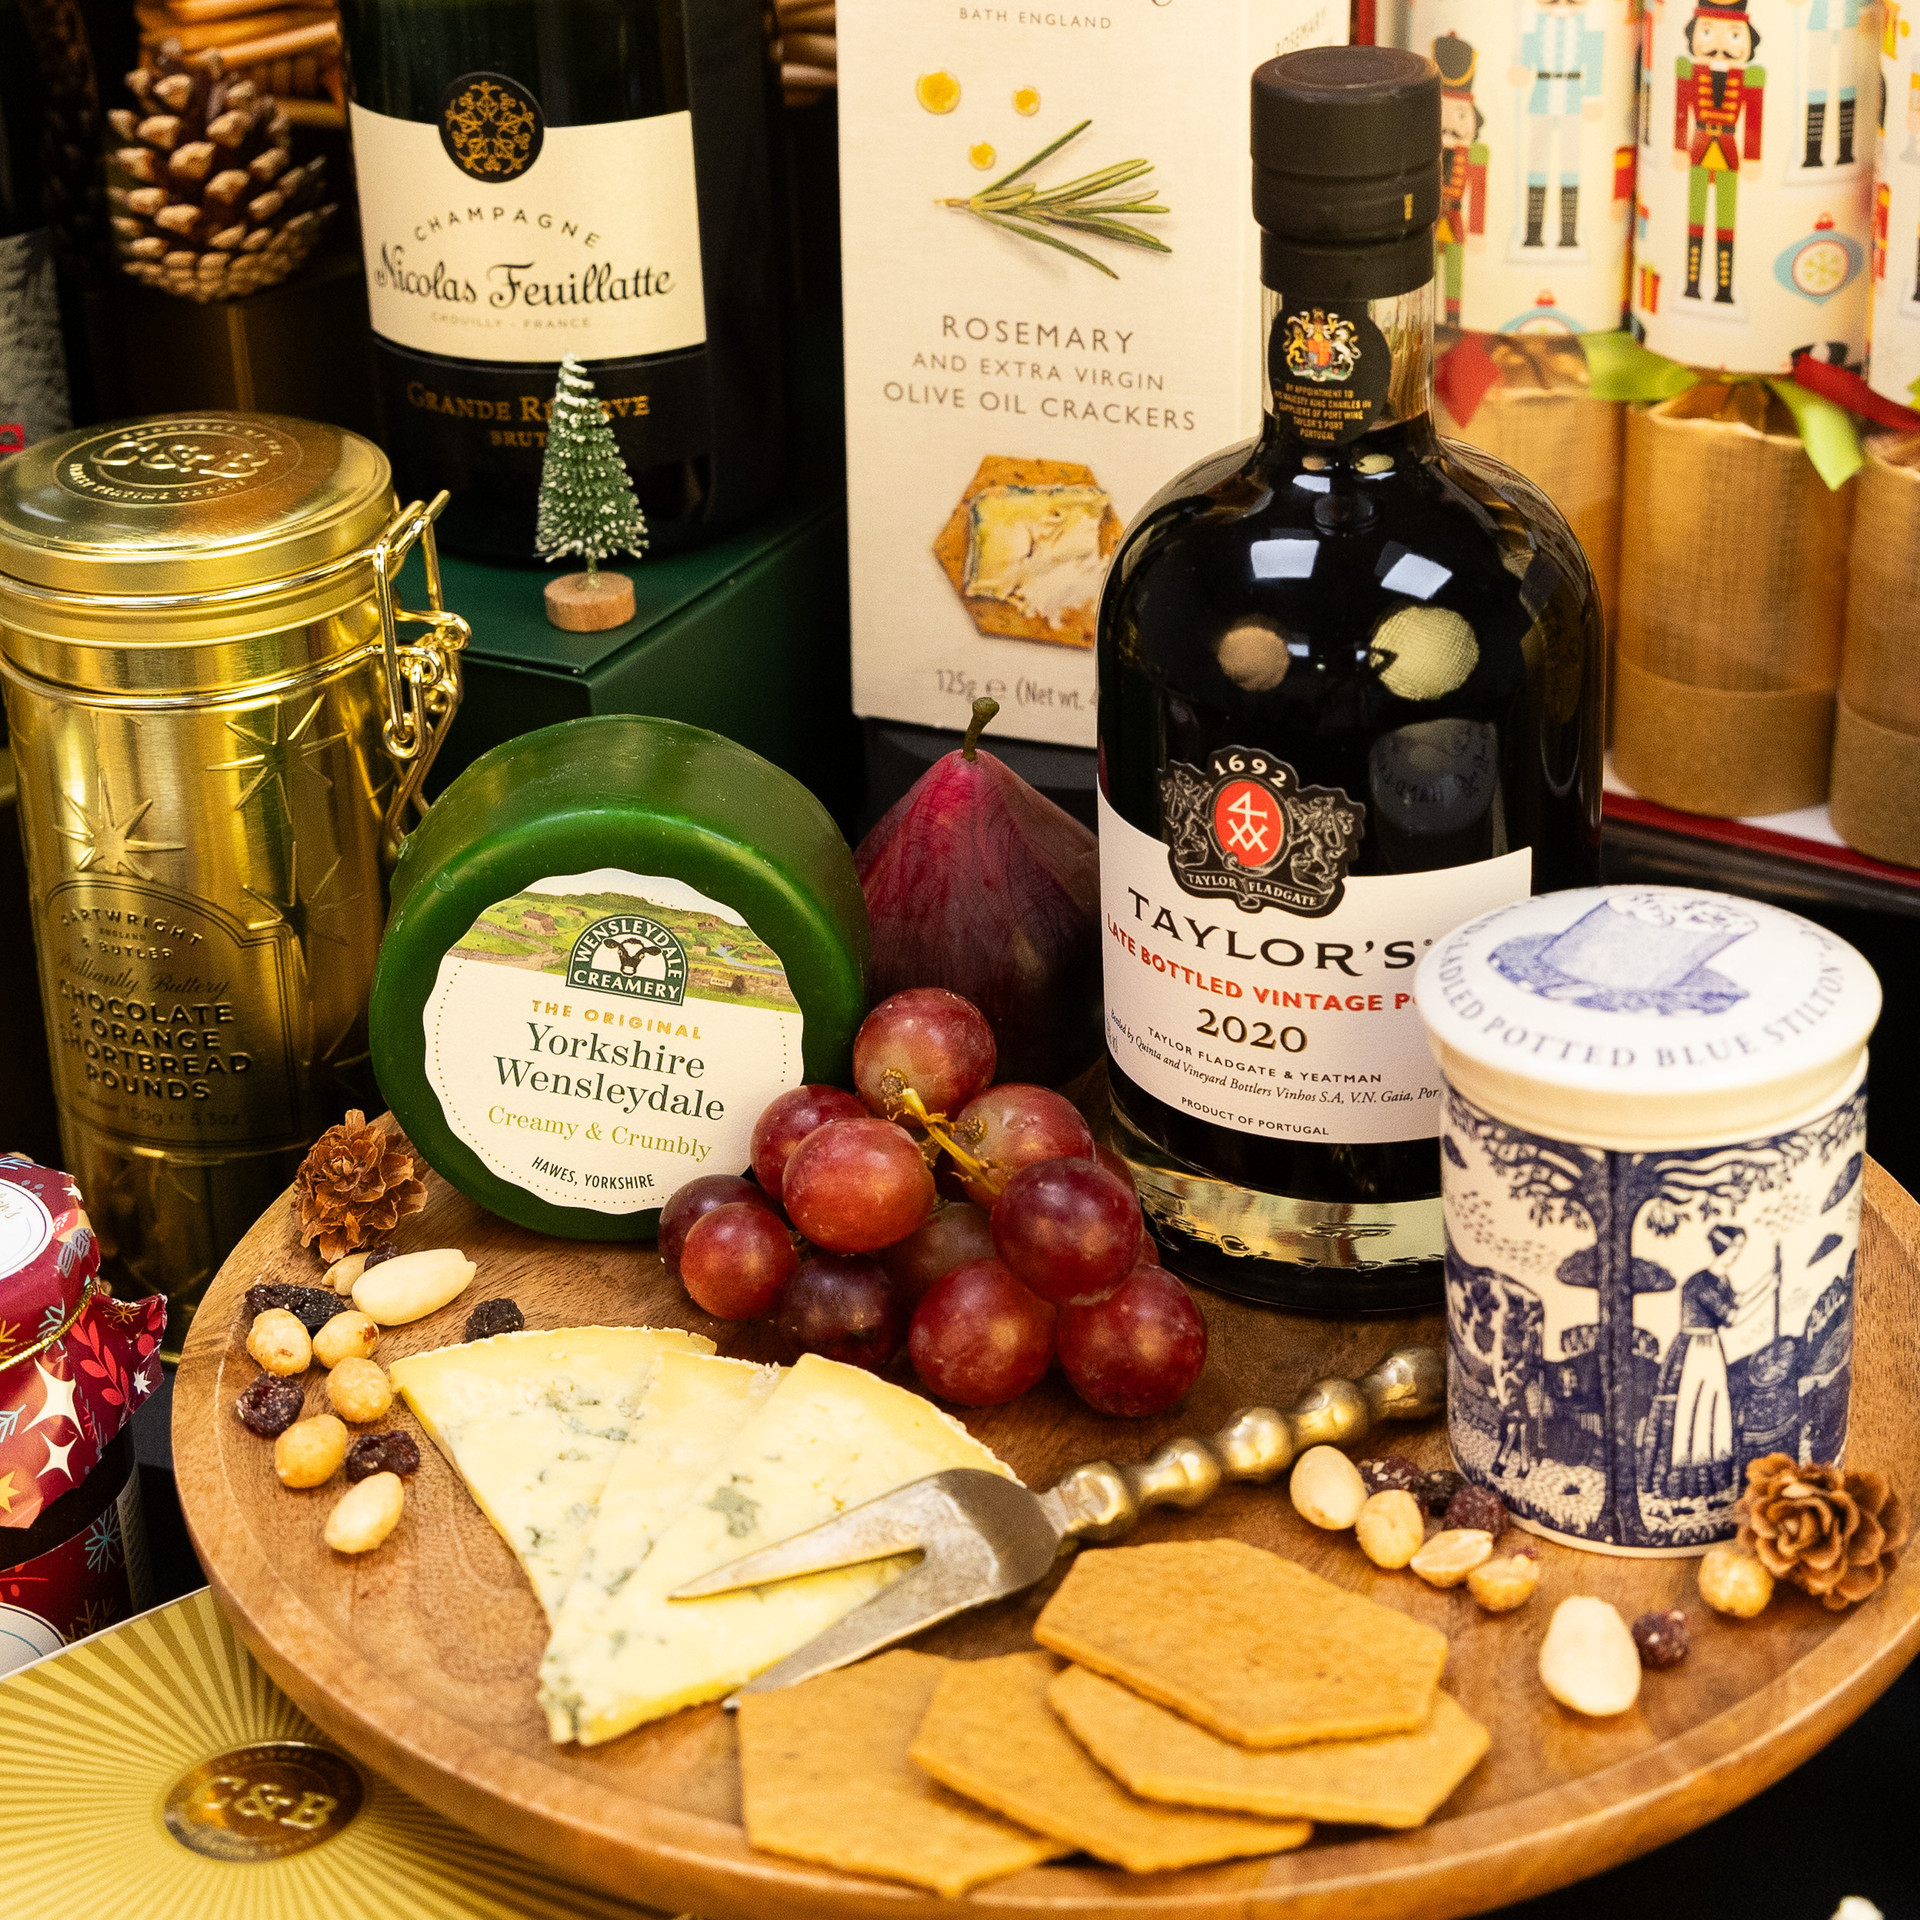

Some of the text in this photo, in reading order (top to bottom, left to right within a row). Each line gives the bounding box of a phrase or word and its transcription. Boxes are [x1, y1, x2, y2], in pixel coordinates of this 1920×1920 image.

[959, 7, 1112, 29] BATH ENGLAND
[414, 207, 601, 248] CHAMPAGNE
[375, 242, 676, 308] Nicolas Feuillatte
[523, 318, 591, 328] FRANCE
[942, 315, 1134, 354] ROSEMARY
[912, 352, 1164, 391] AND EXTRA VIRGIN
[883, 382, 1195, 431] OLIVE OIL CRACKERS
[1328, 400, 1360, 409] CHARLES
[1344, 410, 1363, 420] WINE
[490, 430, 548, 447] BRUT
[1300, 428, 1335, 440] PORTUGAL
[937, 669, 977, 704] 125g
[1015, 676, 1053, 707] (Net
[1214, 754, 1287, 788] 1692
[1187, 873, 1318, 907] TAYLOR FLADGATE
[61, 908, 203, 945] CARTWRIGHT
[100, 928, 146, 941] ENGLAND
[99, 940, 173, 960] BUTLER
[575, 918, 683, 979] WENSLEYDALE
[1107, 912, 1416, 1012] LATE BOTTLED VINTAGE P
[59, 978, 235, 1024] CHOCOLATE
[147, 974, 231, 1000] Buttery
[573, 970, 680, 1000] CREAMERY
[71, 1007, 221, 1050] & ORANGE
[532, 999, 702, 1040] THE ORIGINAL
[1197, 1007, 1308, 1053] 2020
[527, 1021, 706, 1079] Yorkshire
[1148, 1026, 1381, 1083] TAYLOR FLADGATE & YEATMAN
[1483, 1016, 1637, 1068] POTTED
[1655, 1034, 1760, 1068] BLUE
[86, 1061, 212, 1101] ROUNDS
[1127, 1029, 1135, 1044] by
[1136, 1036, 1161, 1061] Quinta
[1163, 1056, 1181, 1070] and
[1182, 1062, 1227, 1086] Vineyard
[1230, 1078, 1272, 1097] Bottlers
[1276, 1086, 1316, 1102] Vinhos
[1350, 1091, 1378, 1103] V.N.
[1381, 1090, 1413, 1103] Gaia,
[1417, 1087, 1442, 1100] Por
[493, 1055, 725, 1121] Wensleydale
[488, 1105, 713, 1163] Creamy & Crumbly
[1181, 1096, 1329, 1136] PRODUCT OF PORTUGAL
[531, 1156, 655, 1189] HAWES, YORKSHIRE
[188, 1775, 338, 1830] C&B
